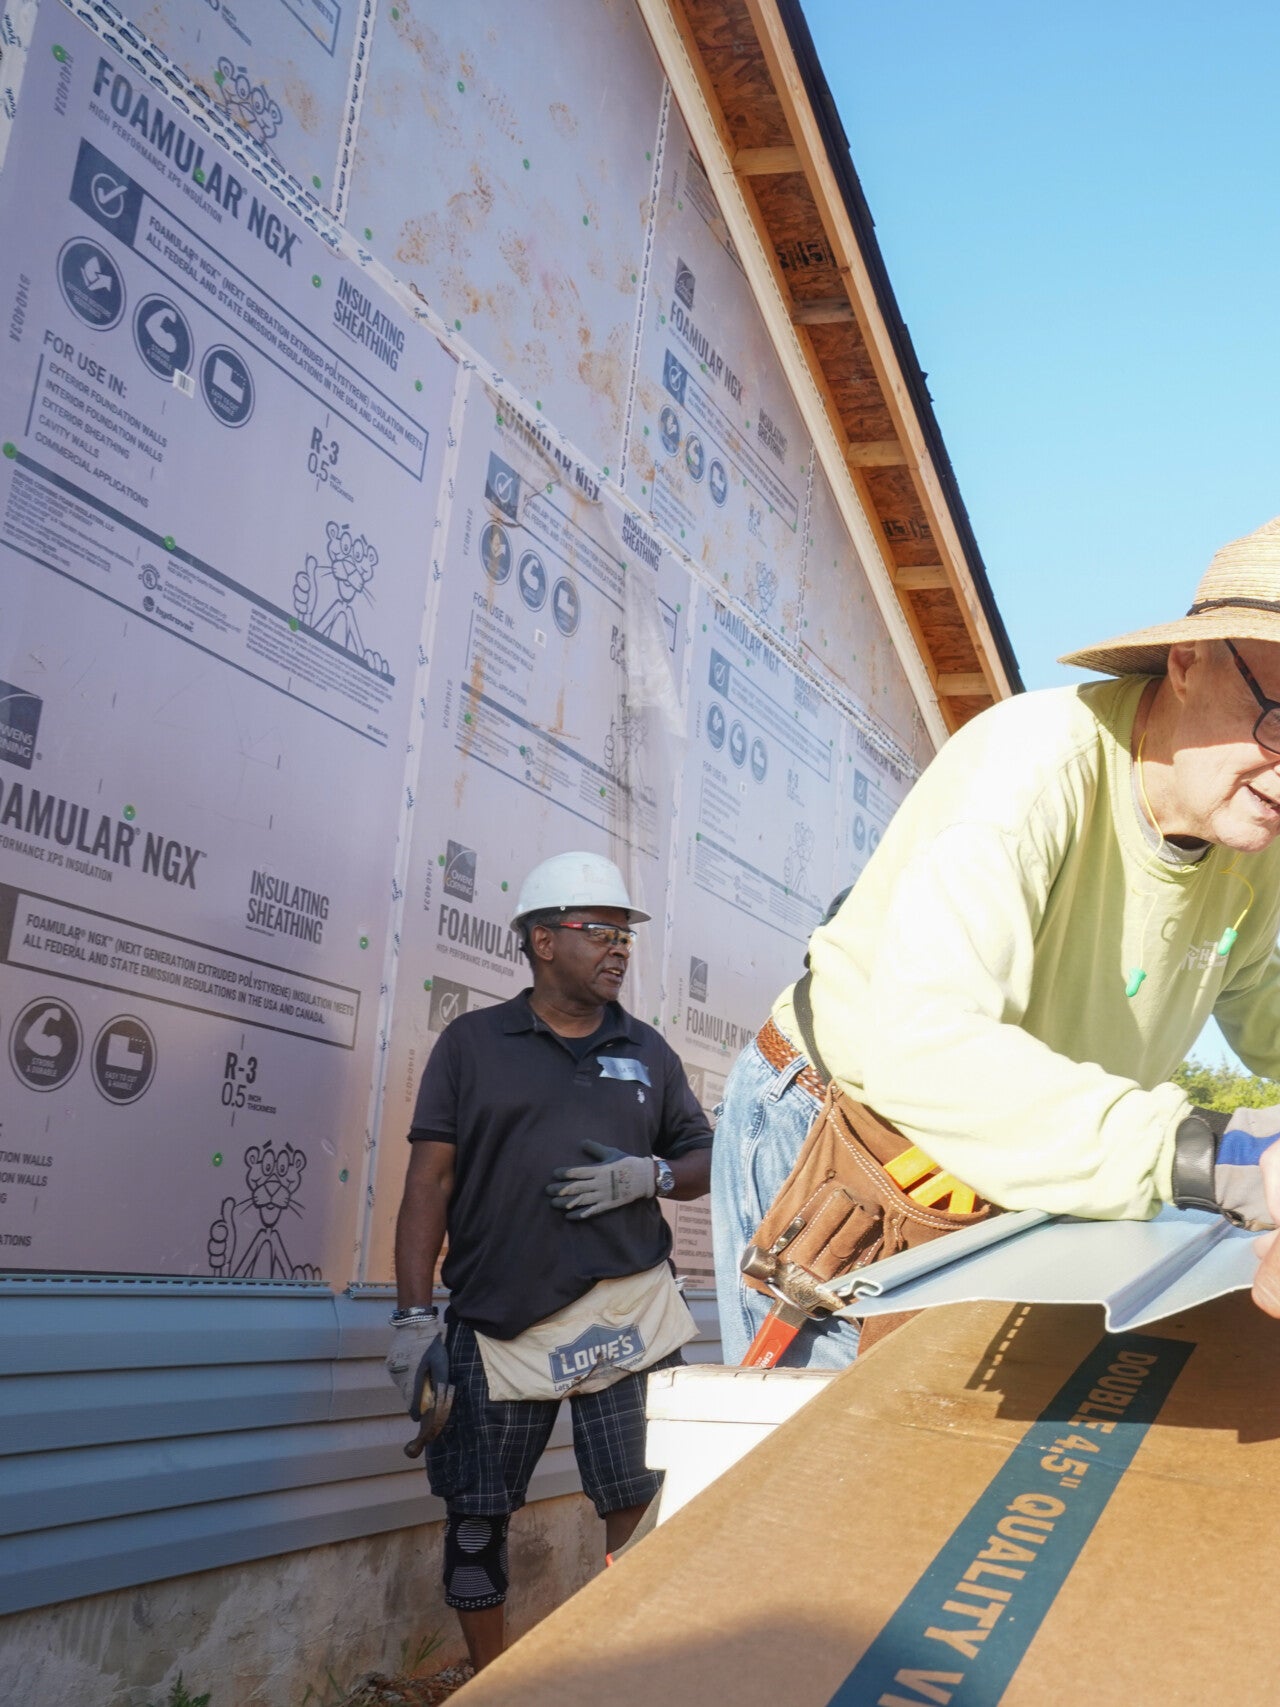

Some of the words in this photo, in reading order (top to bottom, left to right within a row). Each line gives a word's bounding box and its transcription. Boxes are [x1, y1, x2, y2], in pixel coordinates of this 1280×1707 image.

[89, 101, 110, 127] HIGH
[112, 119, 167, 176] PERFORMANCE
[167, 171, 182, 190] XPS
[182, 182, 223, 224] INSULATION
[146, 233, 162, 252] ALL
[164, 247, 199, 281] FEDERAL
[200, 277, 217, 295] AND
[218, 291, 243, 318] STATE
[243, 310, 278, 346] EMISSION
[277, 338, 323, 384] REGULATIONS
[324, 379, 331, 391] IN
[333, 384, 345, 402] THE
[345, 395, 358, 412] USA
[358, 406, 371, 423] AND
[334, 300, 399, 371] SHEATHING
[337, 276, 405, 353] INSULATING
[669, 300, 723, 377] FOAMULAR
[43, 329, 75, 364] FOR
[77, 352, 107, 384] USE
[108, 373, 128, 400] IN:
[222, 276, 246, 302] (NEXT
[246, 297, 290, 341] GENERATION
[290, 333, 324, 368] EXTRUDED
[324, 362, 370, 409] POLYSTYRENE)
[370, 402, 404, 435] INSULATION
[404, 431, 423, 451] MEETS
[42, 396, 84, 429] EXTERIOR
[84, 423, 130, 459] SHEATHING
[46, 379, 85, 411] INTERIOR
[85, 405, 137, 446] FOUNDATION
[137, 438, 163, 463] WALLS
[50, 363, 90, 396] EXTERIOR
[90, 390, 142, 431] FOUNDATION
[142, 423, 168, 448] WALLS
[38, 414, 71, 439] CAVITY
[71, 433, 100, 458] WALLS
[311, 426, 339, 466] R-3
[35, 431, 92, 473] COMMERCIAL
[92, 467, 150, 509] APPLICATIONS
[308, 452, 330, 482] 0.5
[622, 526, 660, 572] SHEATHING
[47, 849, 63, 867] XPS
[65, 857, 113, 883] INSULATION
[247, 897, 323, 945] SHEATHING
[250, 870, 330, 920] INSULATING
[22, 932, 42, 950] ALL
[44, 939, 87, 961] FEDERAL
[88, 951, 108, 967] AND
[109, 956, 140, 975] STATE
[140, 965, 181, 989] EMISSION
[182, 975, 236, 1002] REGULATIONS
[237, 990, 247, 1002] IN
[248, 993, 262, 1008] THE
[263, 997, 279, 1011] USA
[279, 1001, 295, 1016] AND
[114, 938, 143, 957] (NEXT
[144, 946, 196, 974] GENERATION
[197, 962, 237, 983] EXTRUDED
[238, 974, 292, 1000] POLYSTYRENE)
[292, 990, 333, 1010] INSULATION
[333, 1000, 355, 1017] MEETS
[450, 946, 480, 966] PERFORMANCE
[686, 1006, 738, 1049] FOAMULAR
[32, 1057, 55, 1069] STRONG
[224, 1052, 258, 1084] R-3
[221, 1082, 247, 1108] 0.5
[17, 1173, 48, 1187] WALLS
[22, 1153, 53, 1167] WALLS
[560, 1334, 634, 1376] LOWE'S
[1067, 1350, 1158, 1434] DOUBLE
[924, 1492, 1067, 1660] QUALITY
